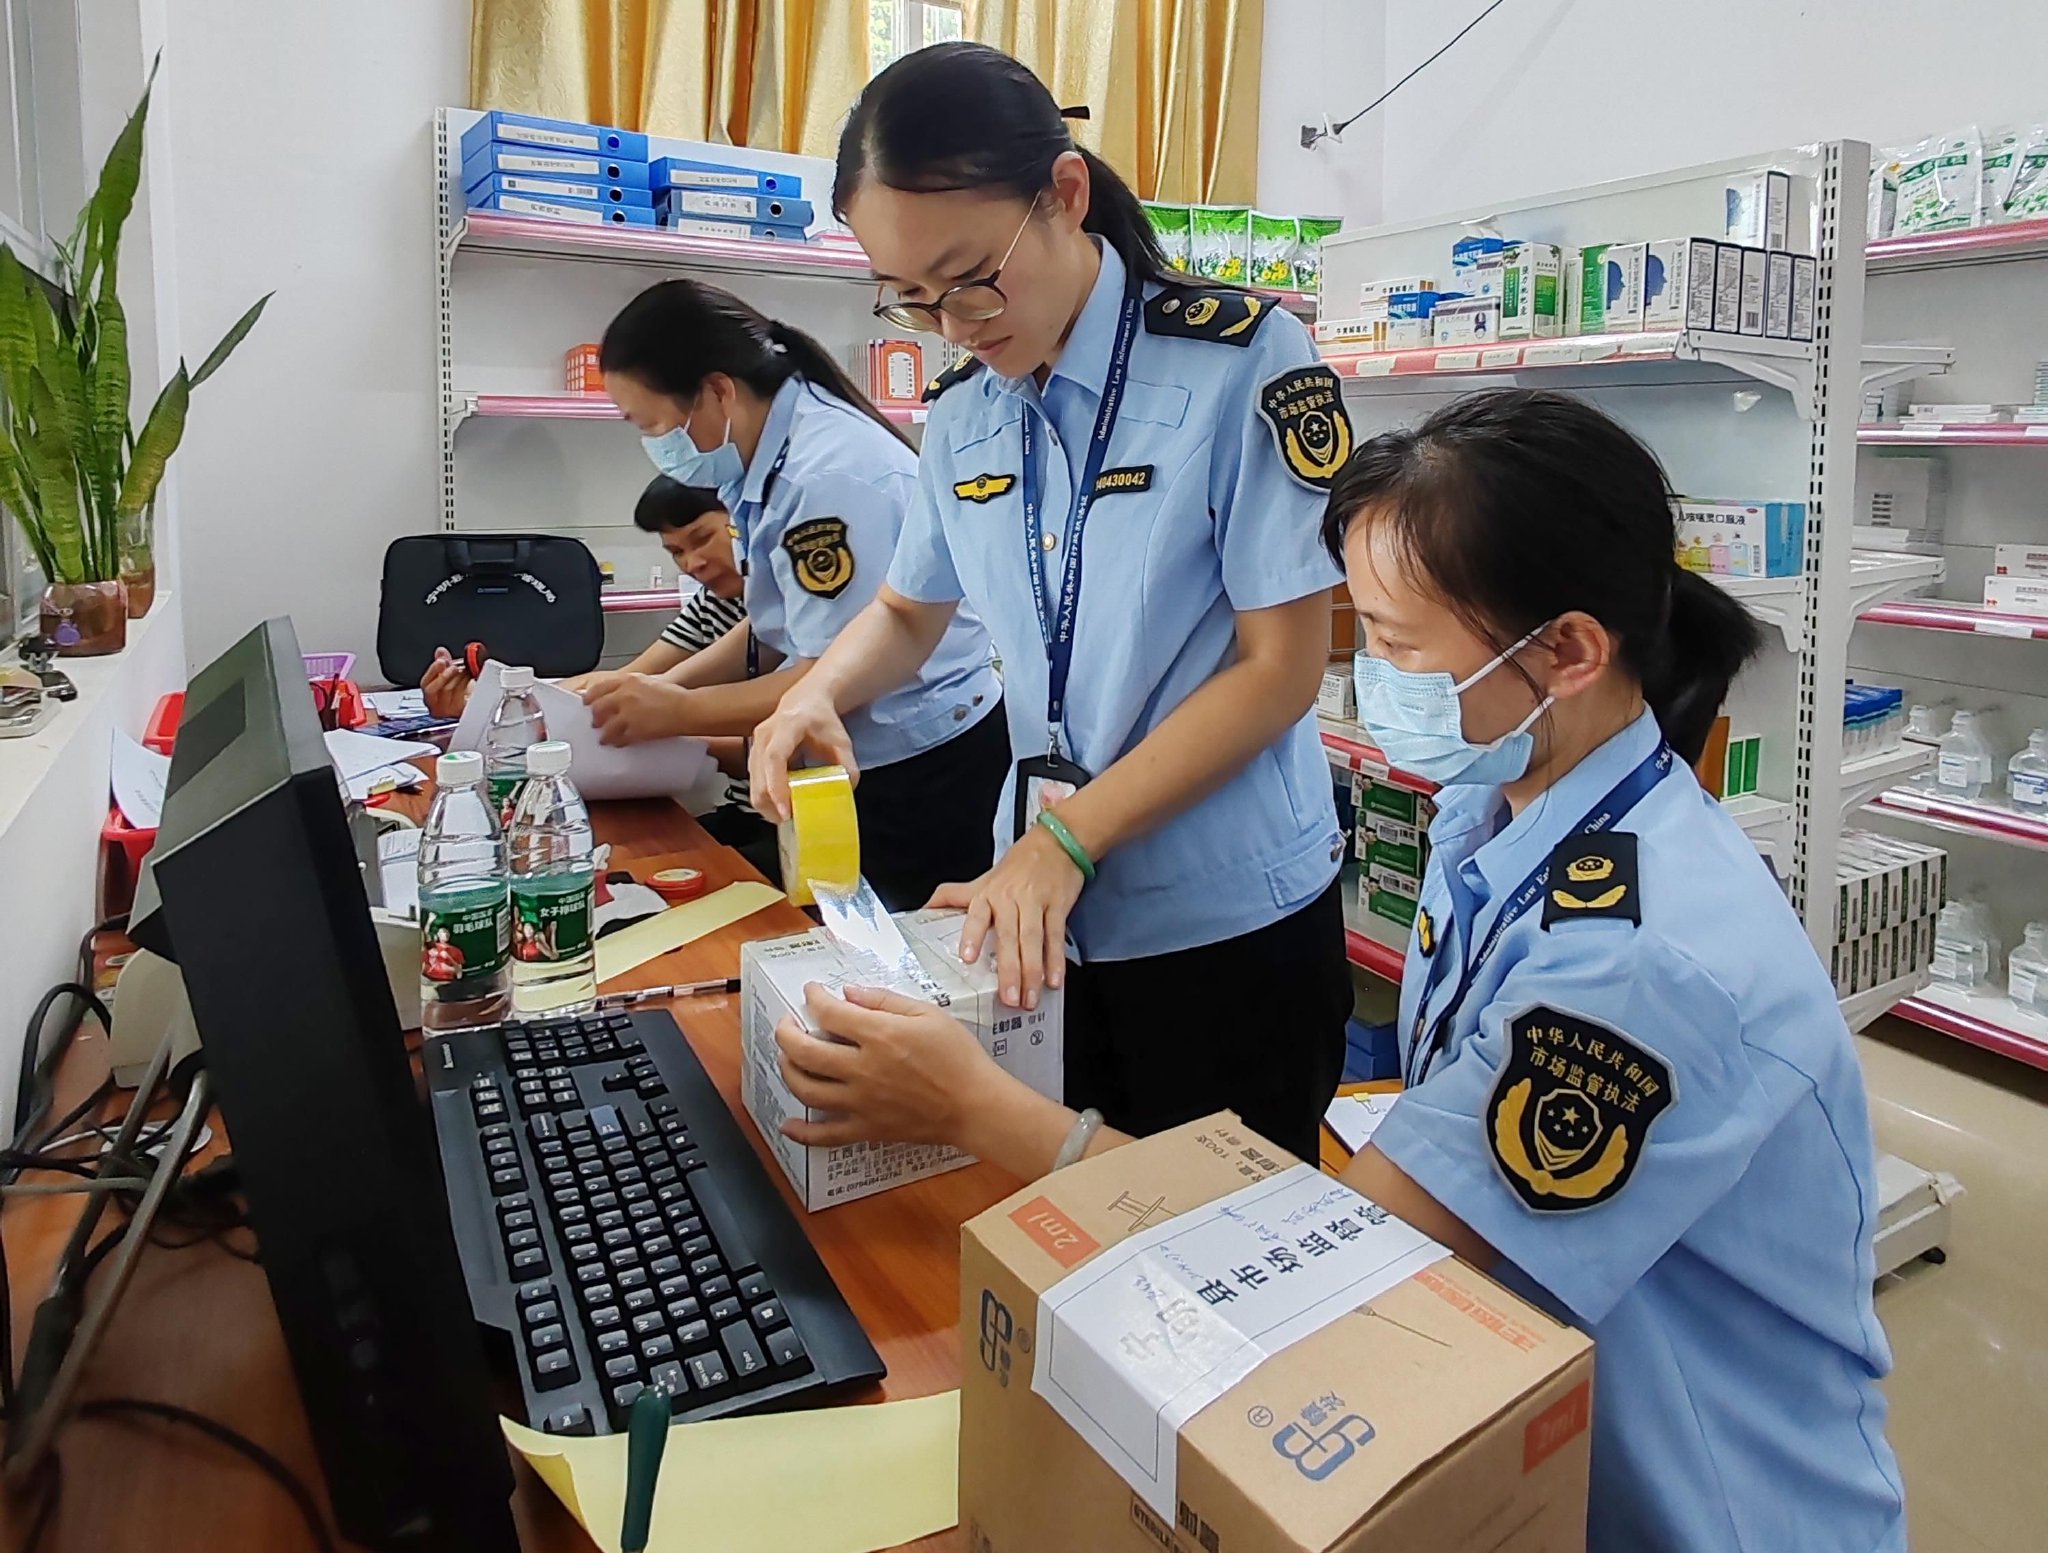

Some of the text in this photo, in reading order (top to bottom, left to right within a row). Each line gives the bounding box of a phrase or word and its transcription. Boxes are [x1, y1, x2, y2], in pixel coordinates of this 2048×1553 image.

[1097, 387, 1117, 441] Administrative
[1114, 368, 1122, 385] Law
[1267, 376, 1334, 409] 中华人民共和国
[1517, 884, 1538, 906] Law
[453, 916, 494, 934] 羽毛球队
[1526, 1025, 1660, 1097] 中华人民共和国
[1528, 1045, 1642, 1114] 市场监管执法
[1026, 1212, 1079, 1250] 2ml
